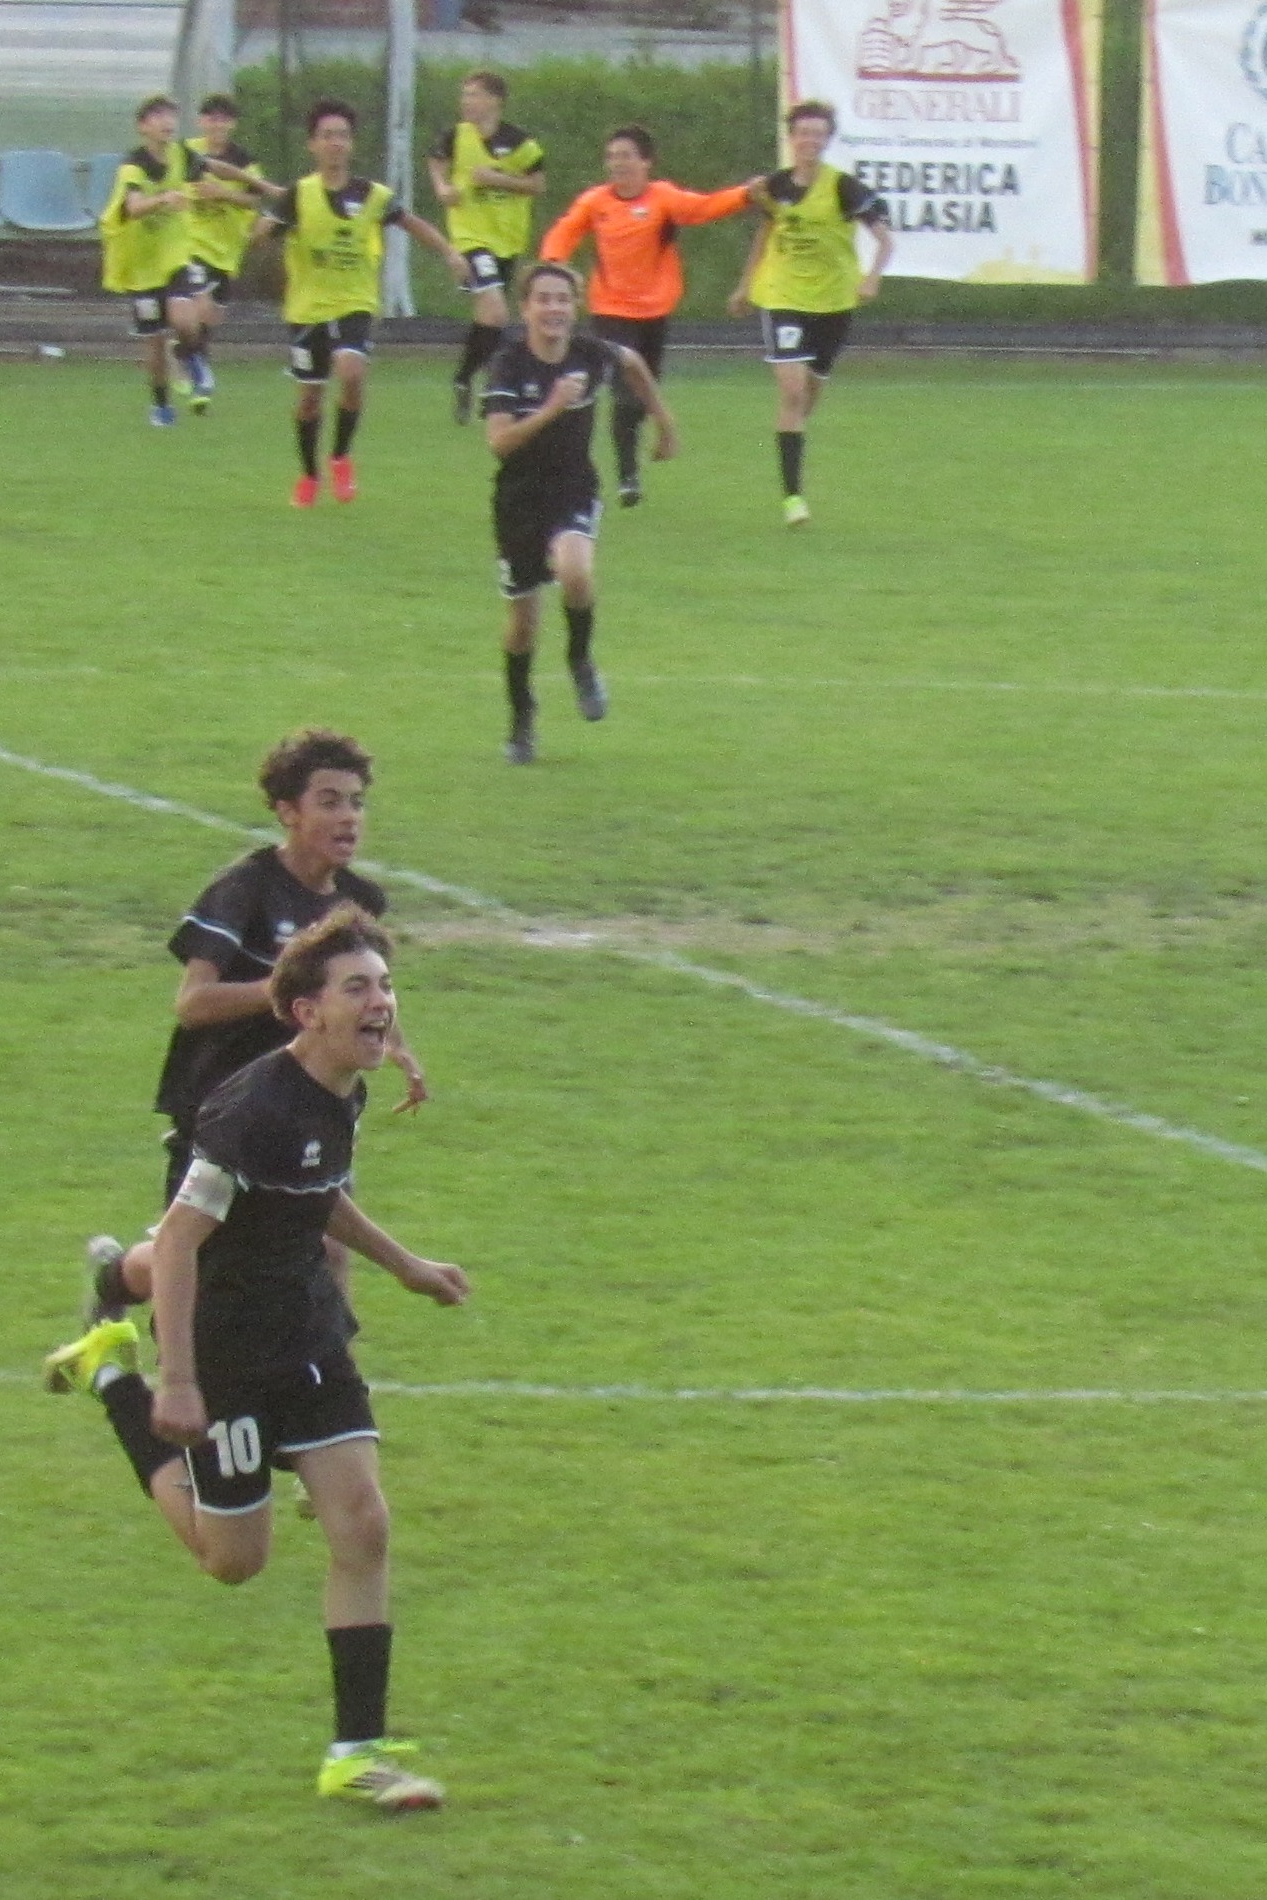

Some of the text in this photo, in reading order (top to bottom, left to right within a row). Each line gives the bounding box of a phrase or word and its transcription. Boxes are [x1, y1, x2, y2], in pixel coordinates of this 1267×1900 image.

[853, 88, 1022, 122] GENERALI
[854, 160, 1021, 195] FEDERICA
[206, 1415, 262, 1478] 10
